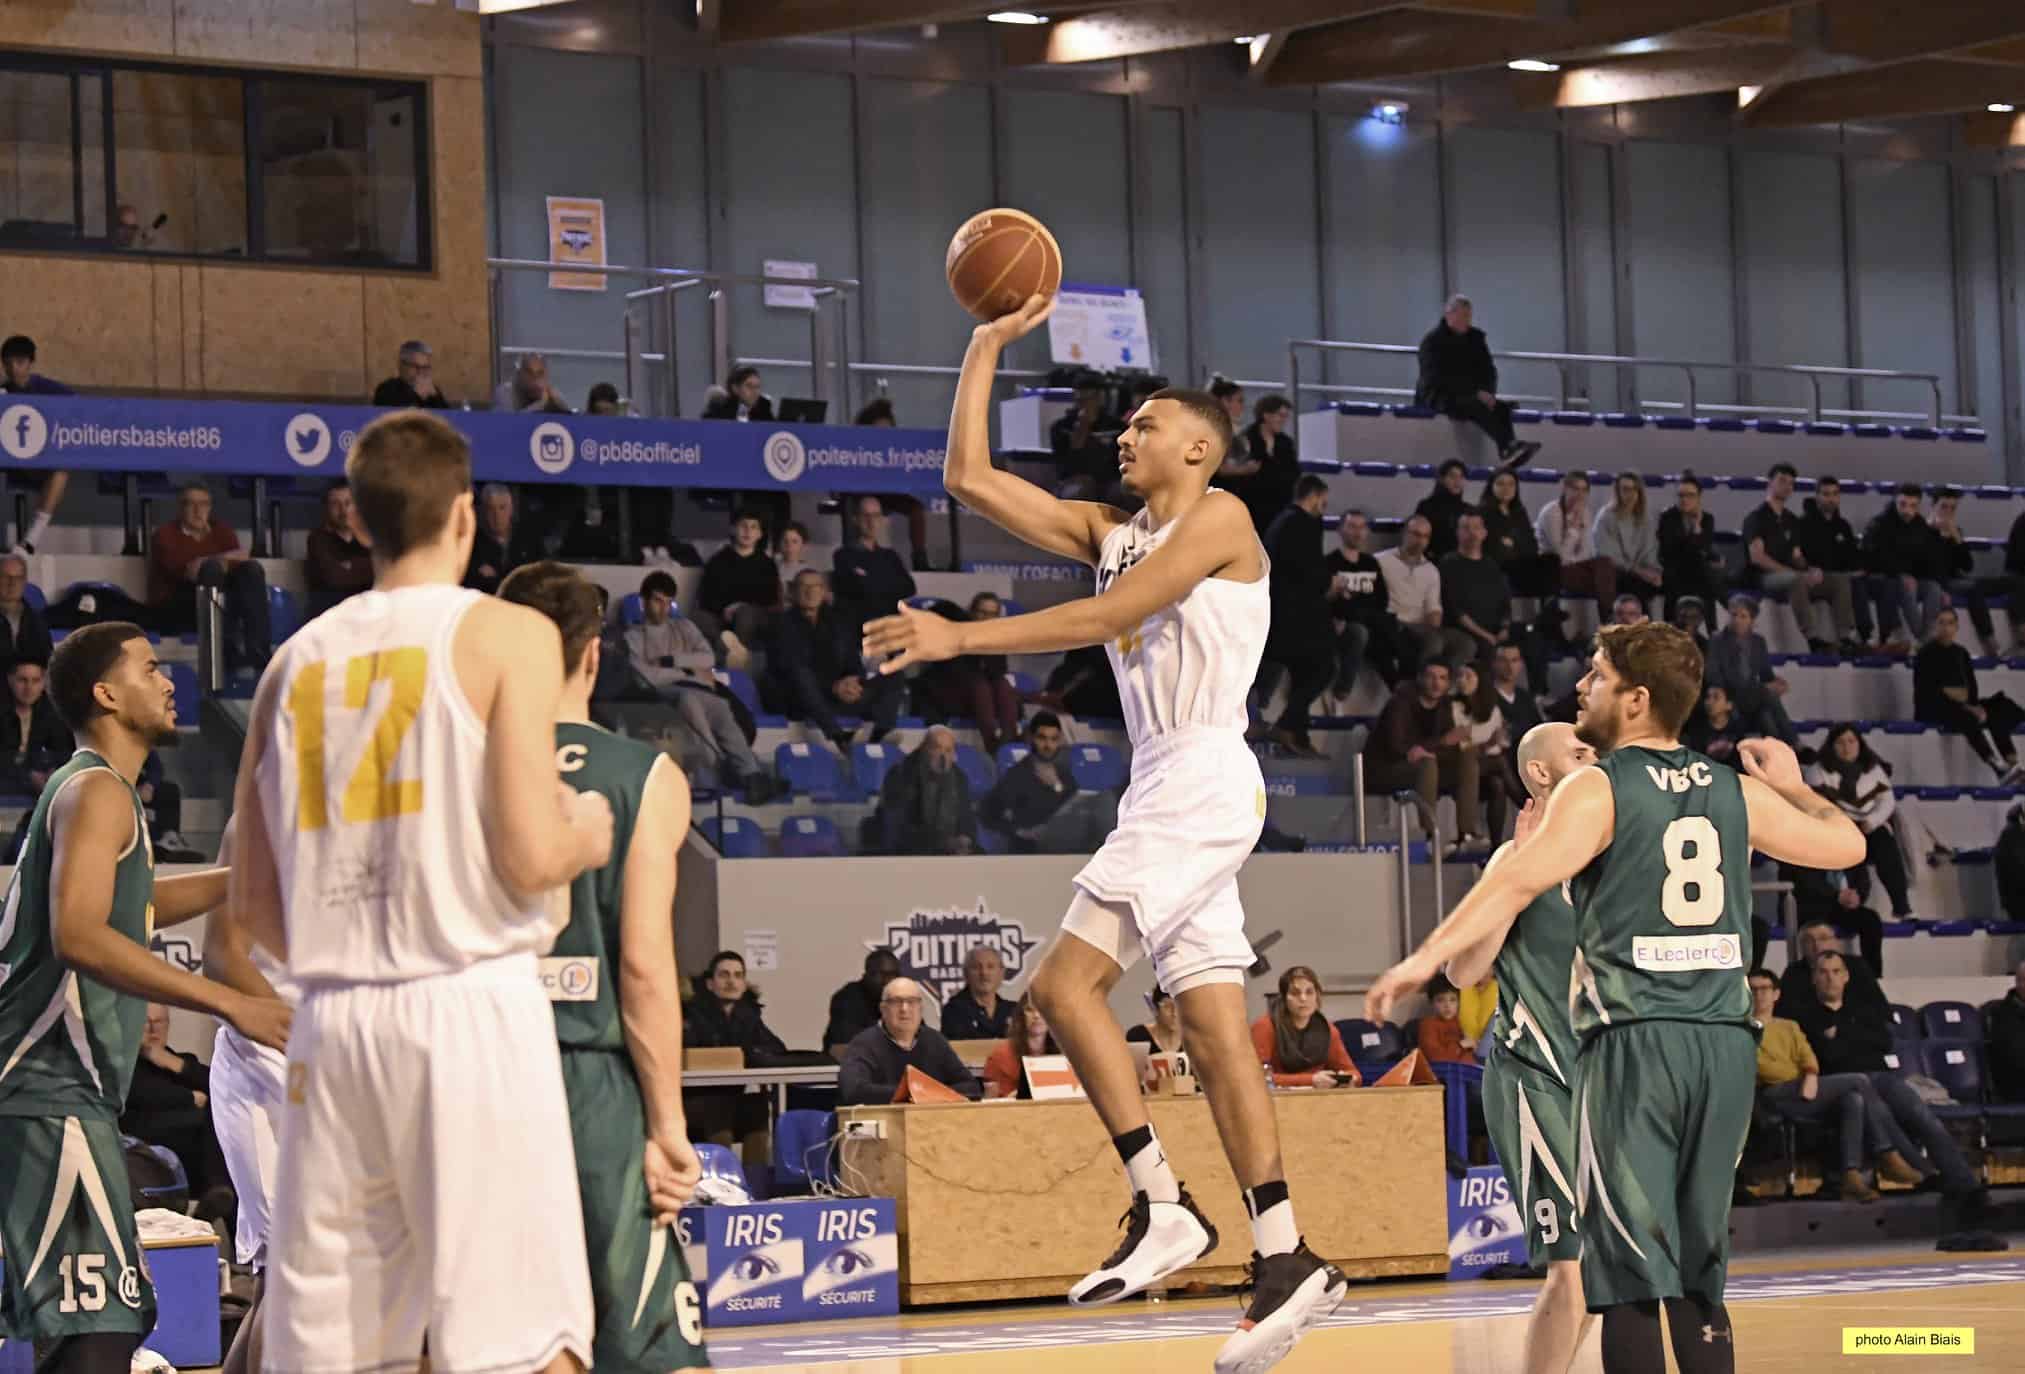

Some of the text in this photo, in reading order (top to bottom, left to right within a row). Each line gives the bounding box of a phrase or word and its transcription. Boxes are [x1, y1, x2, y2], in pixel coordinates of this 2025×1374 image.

[51, 420, 221, 449] /poitiersbasket86
[580, 438, 700, 465] @pb86officiel
[288, 646, 428, 832] 12
[1646, 761, 1713, 793] VBC
[1661, 815, 1725, 927] 8
[1459, 1176, 1510, 1208] IRIS
[725, 1213, 784, 1248] IRIS
[817, 1208, 878, 1242] IRIS
[1534, 1199, 1560, 1245] 9
[59, 1254, 107, 1313] 15
[819, 1288, 876, 1306] SÉCURITÉ
[726, 1293, 783, 1312] SÉCURITÉ
